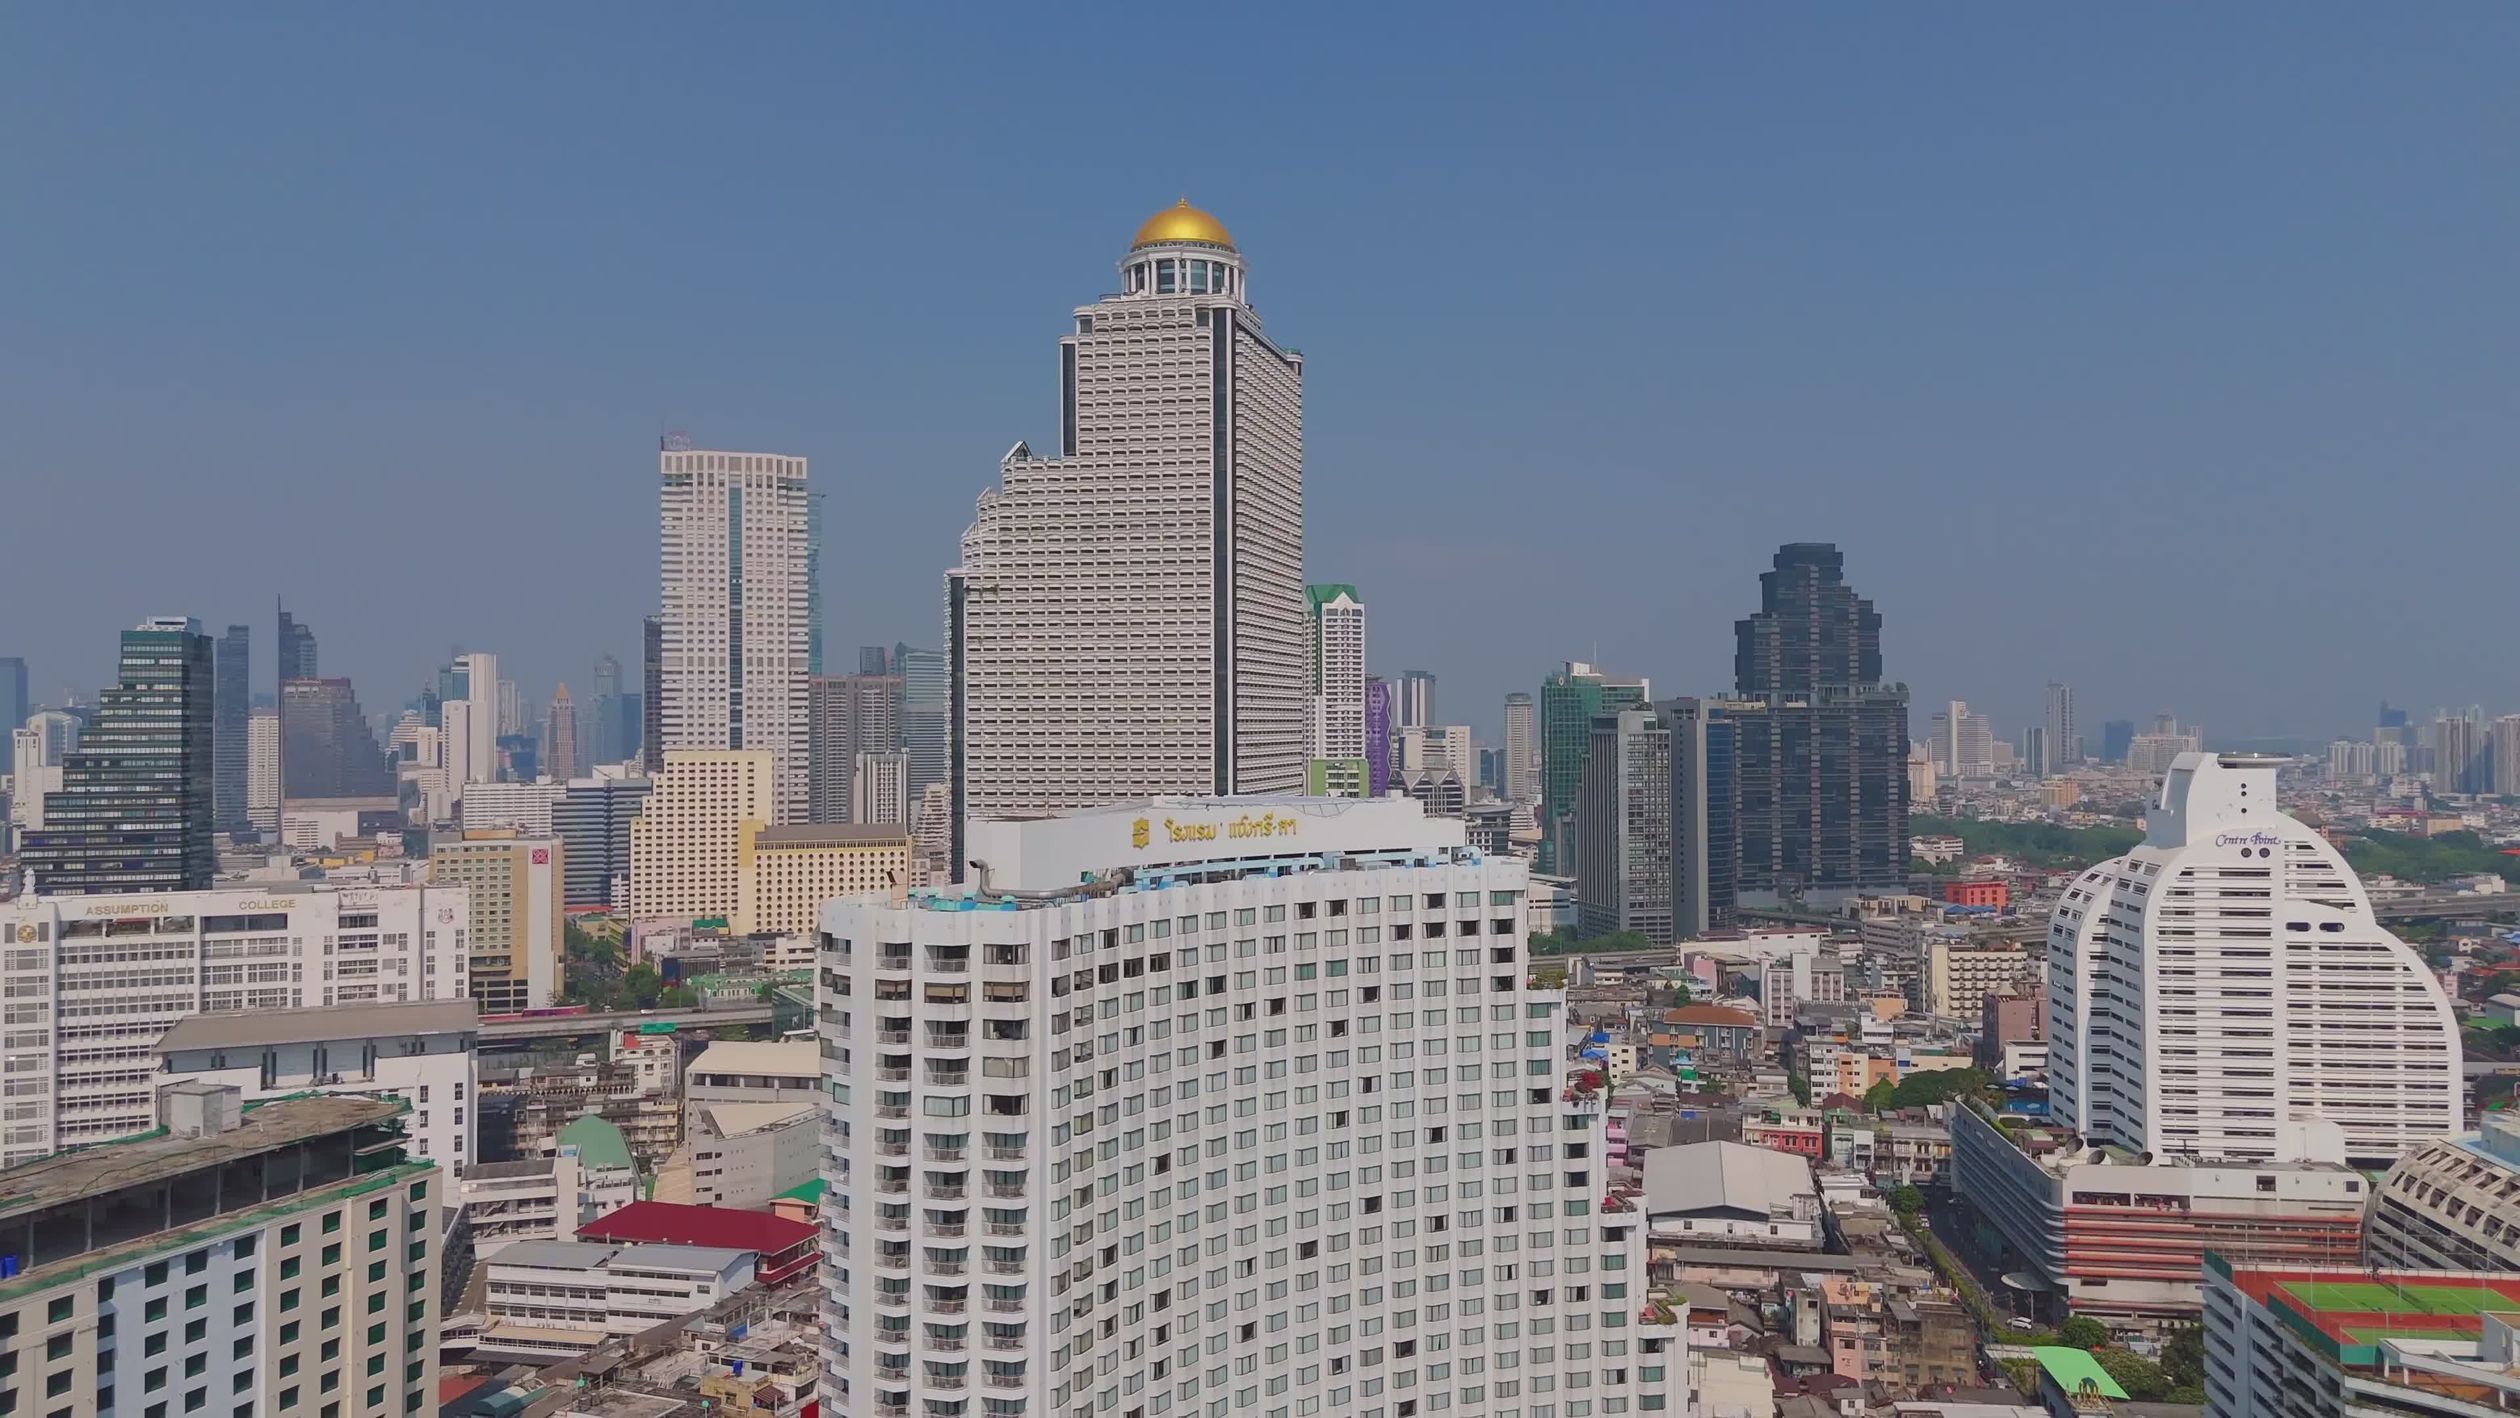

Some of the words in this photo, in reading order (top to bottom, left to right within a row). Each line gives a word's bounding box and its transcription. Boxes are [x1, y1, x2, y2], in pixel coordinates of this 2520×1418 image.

[2215, 834, 2248, 847] Centre
[2251, 832, 2281, 845] Point
[85, 903, 169, 916] ASSUMPTION
[239, 899, 297, 911] COLLEGE
